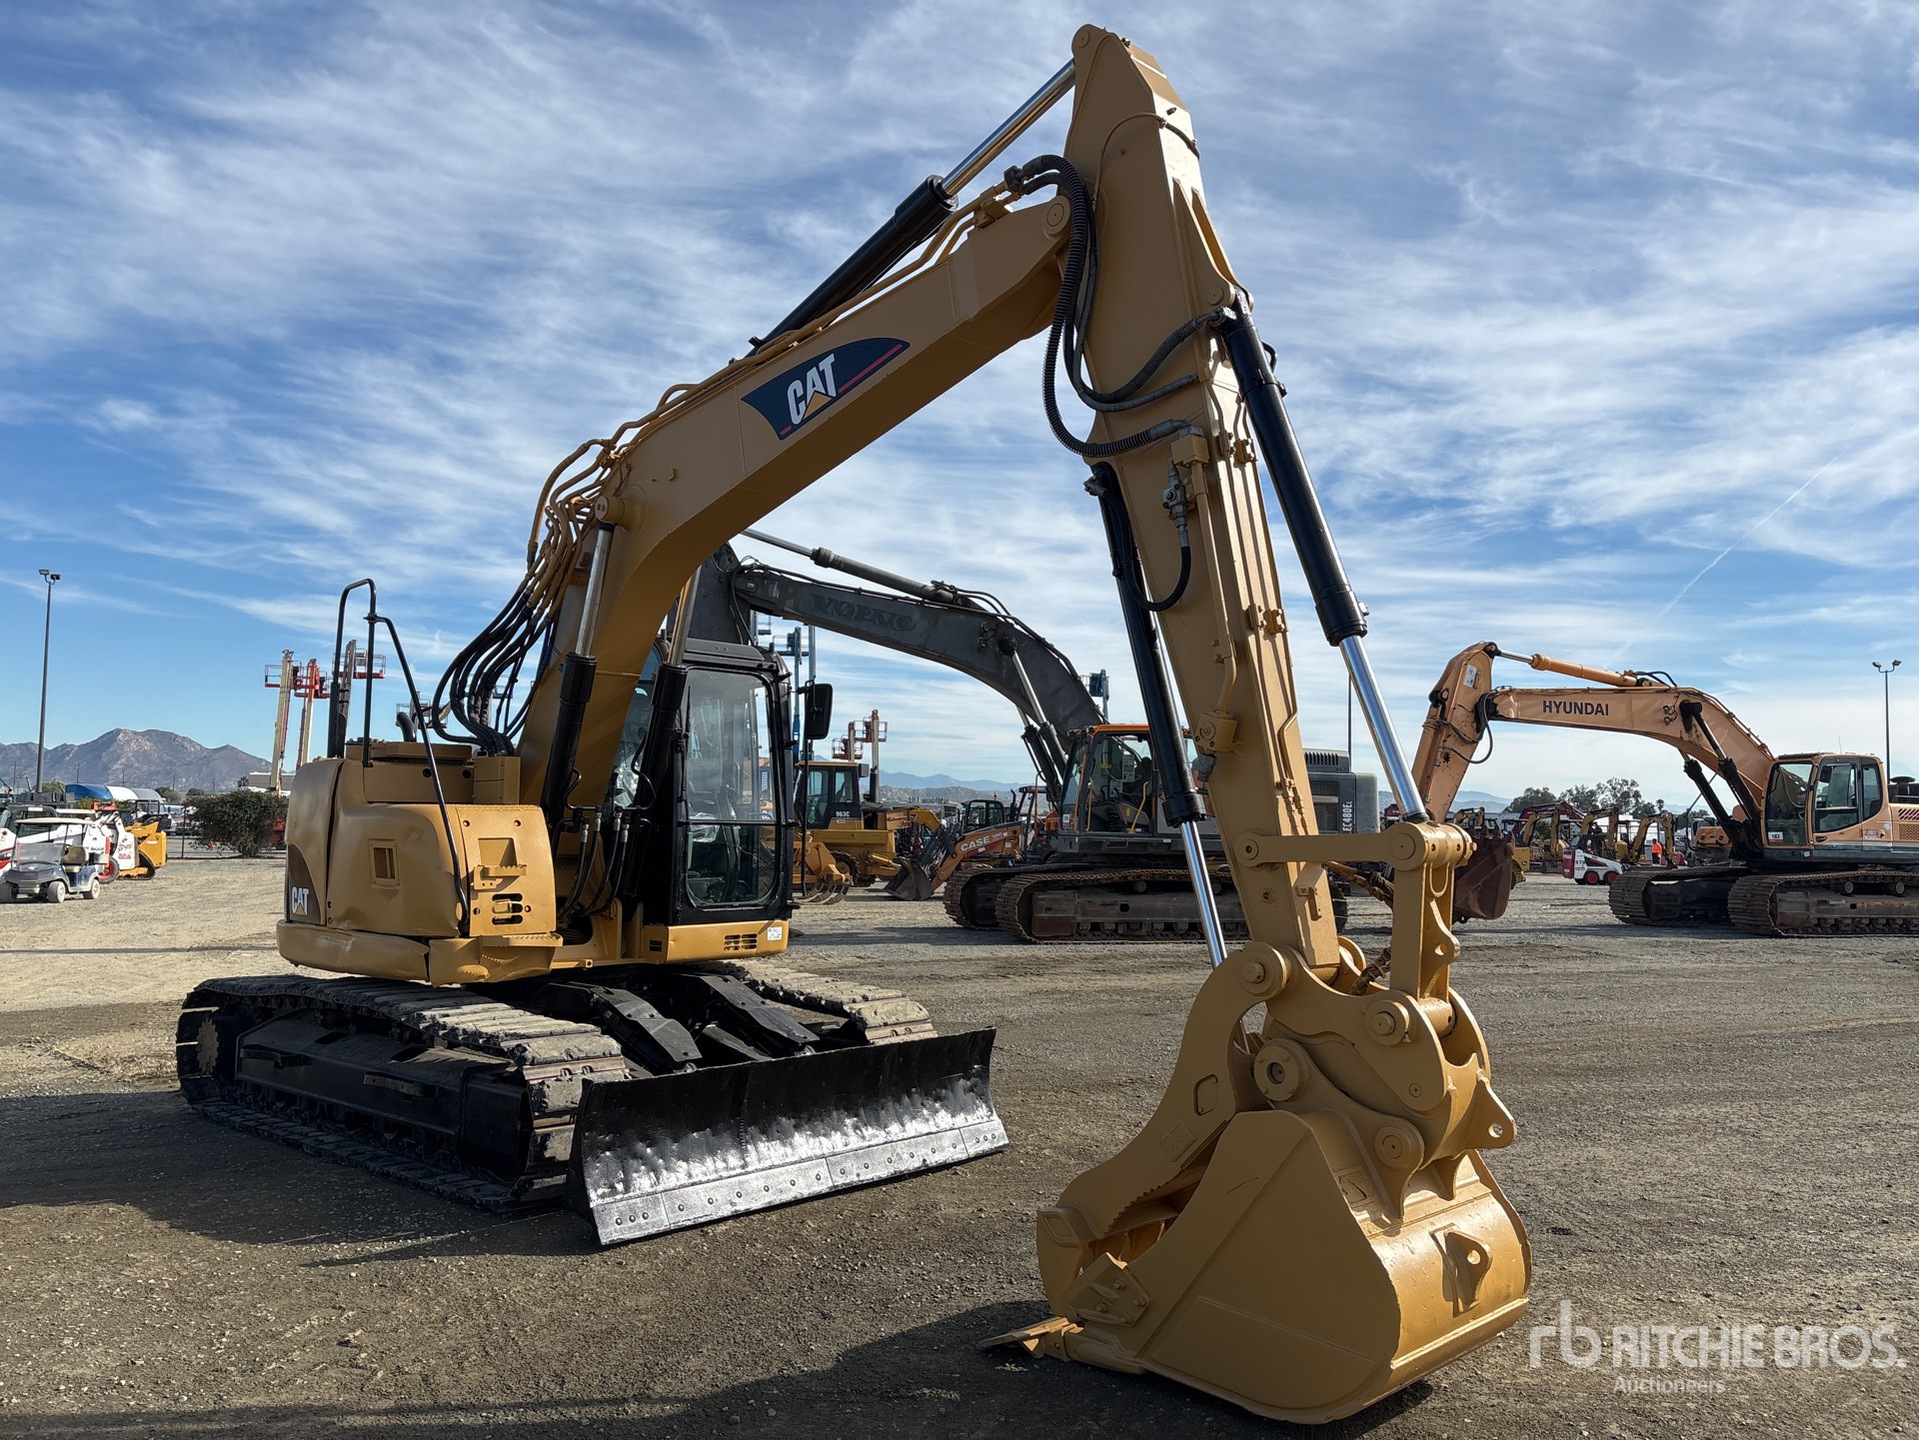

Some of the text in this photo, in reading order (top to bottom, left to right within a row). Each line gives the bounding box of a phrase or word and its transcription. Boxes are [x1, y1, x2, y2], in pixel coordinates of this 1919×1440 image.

[787, 353, 837, 425] CAT
[1542, 700, 1609, 716] HYUNDAI
[960, 835, 990, 851] CASE
[291, 886, 309, 916] CAT
